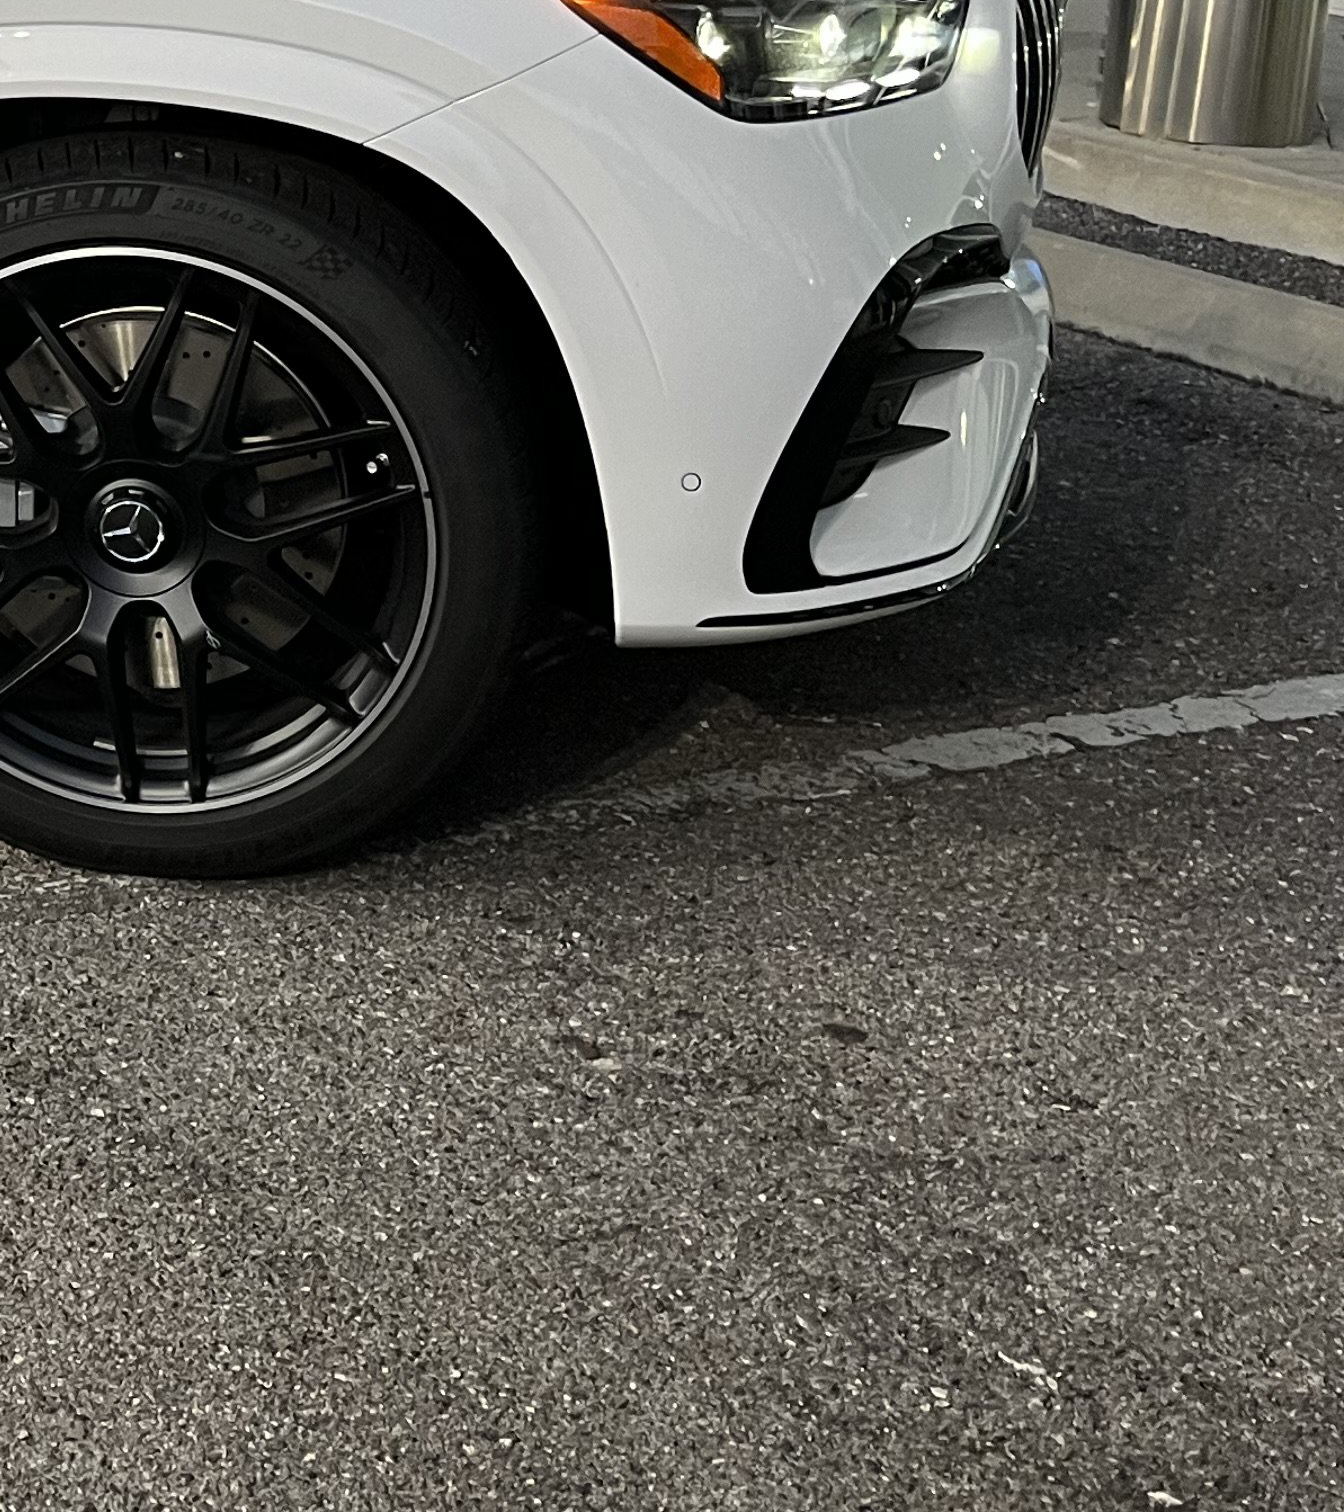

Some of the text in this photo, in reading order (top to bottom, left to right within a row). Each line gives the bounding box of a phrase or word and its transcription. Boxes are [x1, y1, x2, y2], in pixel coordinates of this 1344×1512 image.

[171, 197, 243, 225] 285/40
[246, 217, 275, 235] ZR
[278, 232, 302, 250] 22
